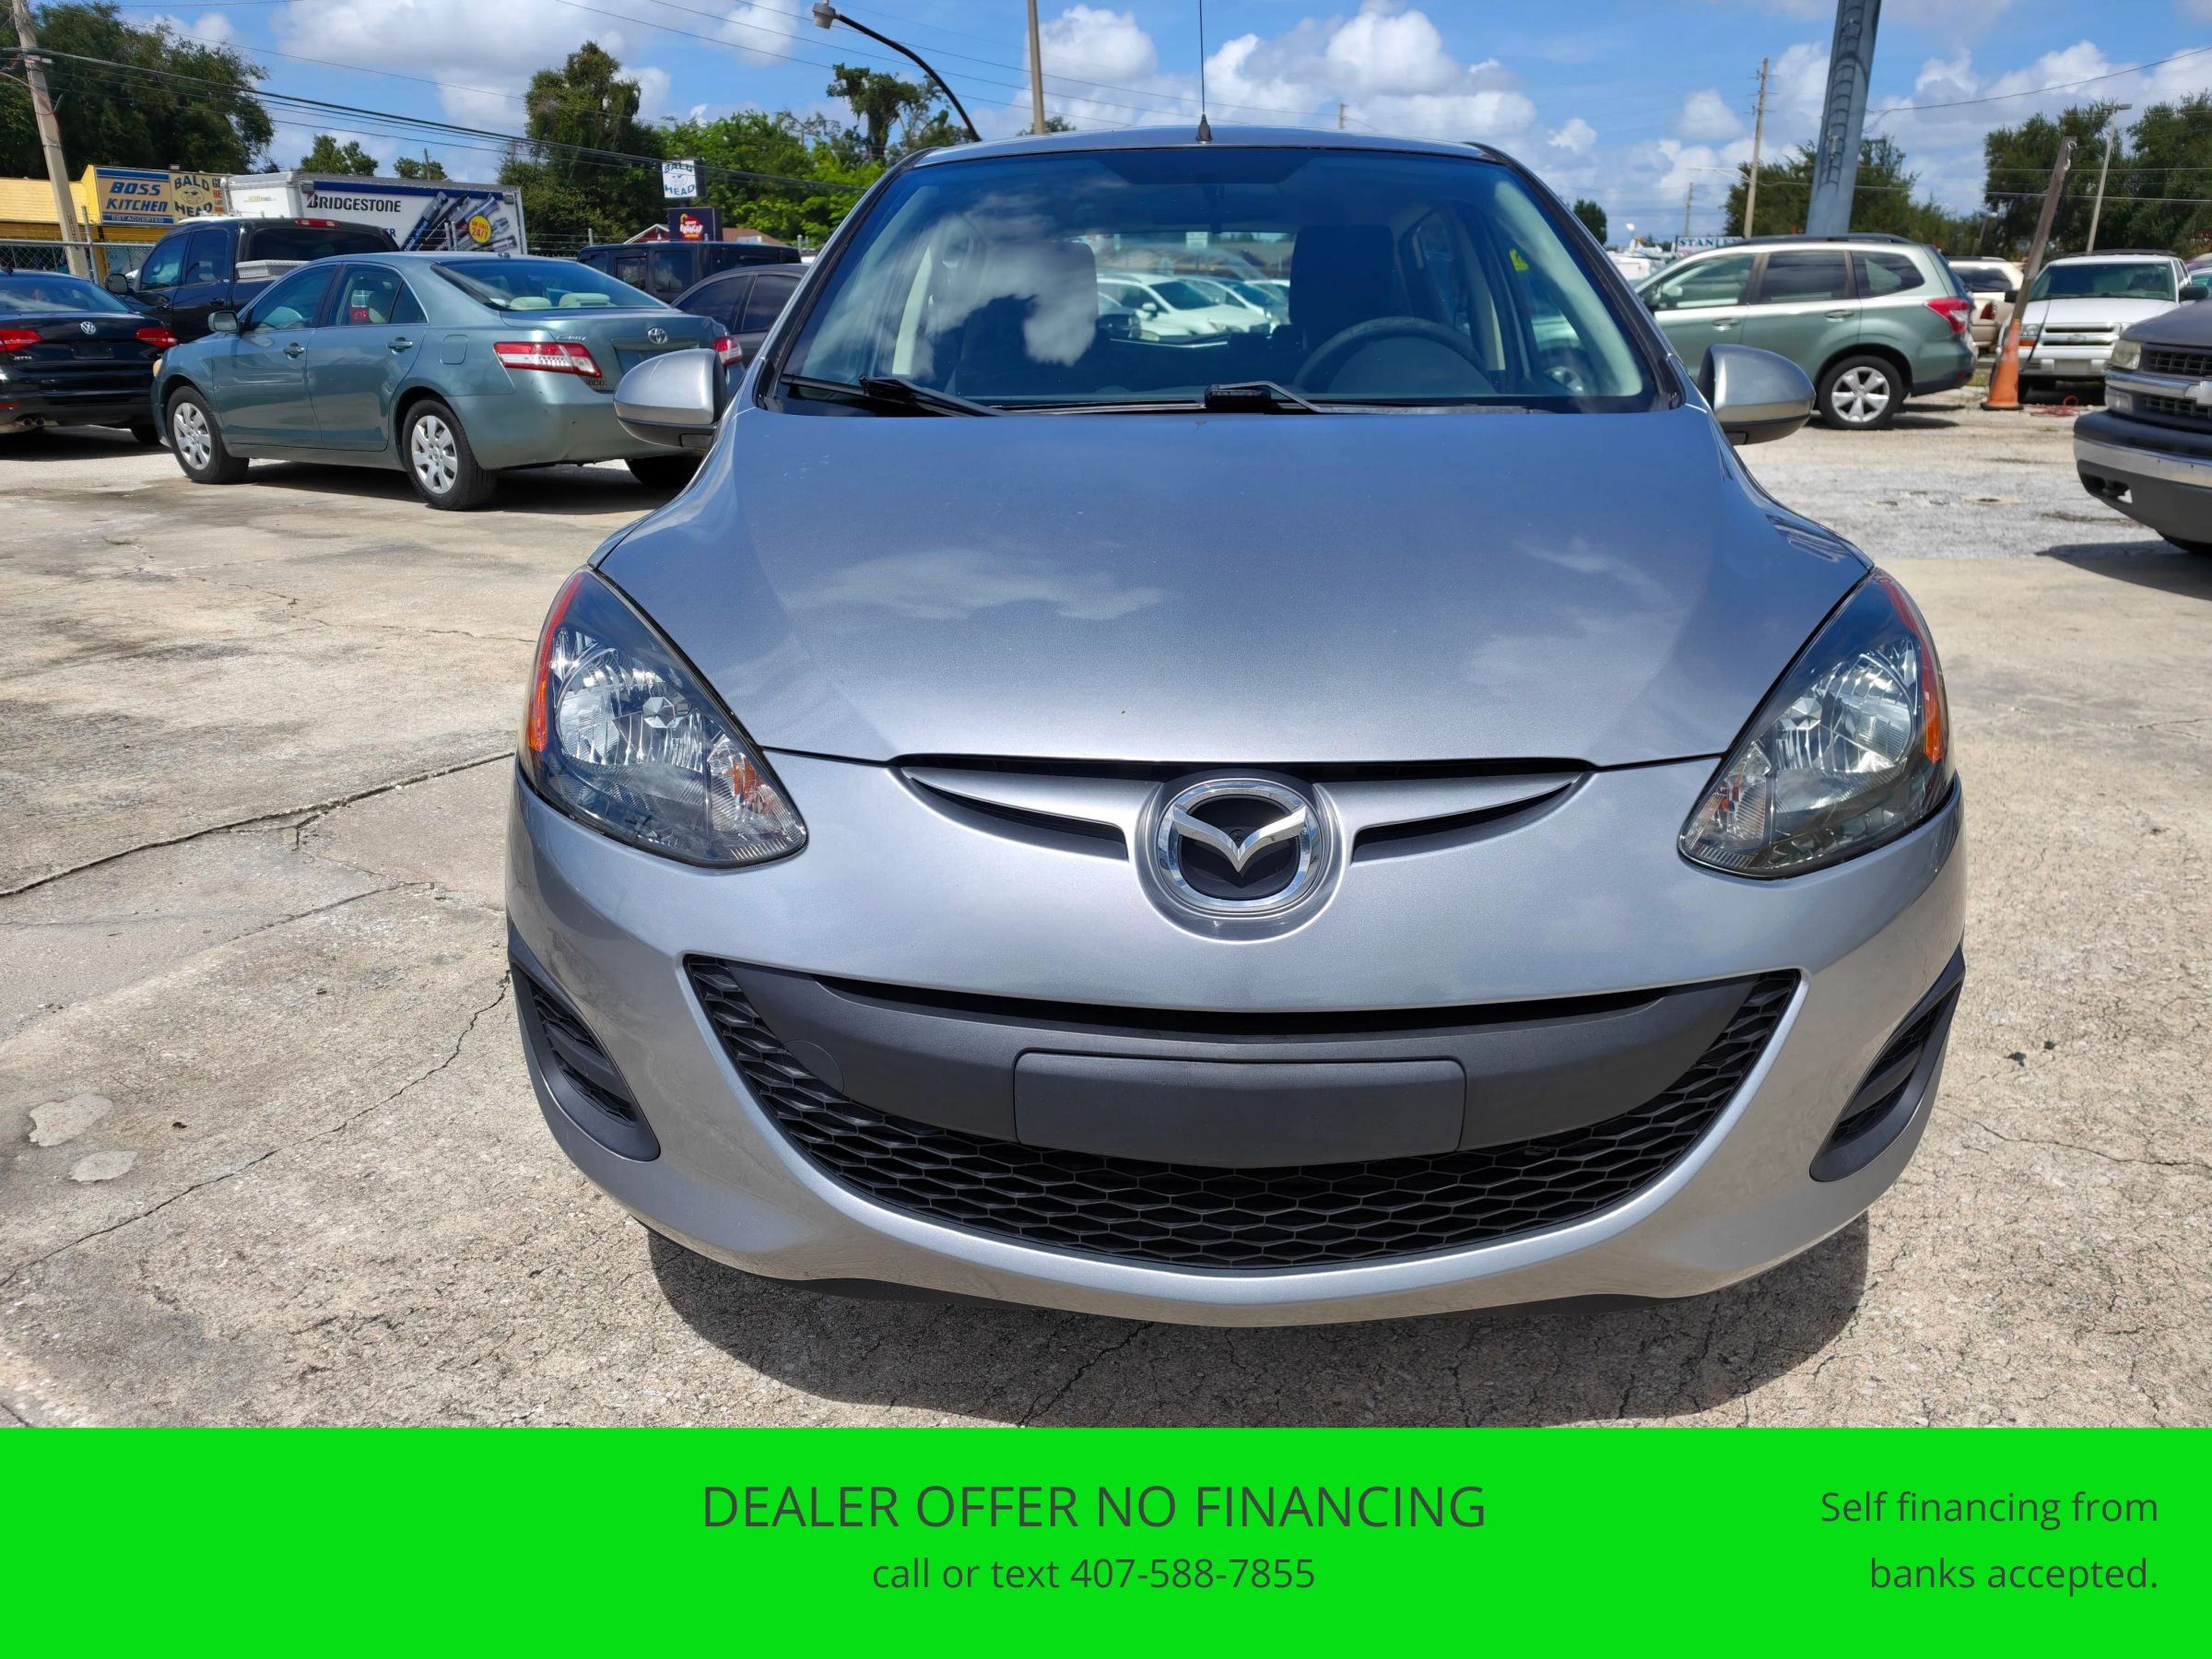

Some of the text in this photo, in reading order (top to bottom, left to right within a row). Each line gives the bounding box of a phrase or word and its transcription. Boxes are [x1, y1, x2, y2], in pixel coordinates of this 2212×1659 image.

[109, 182, 161, 196] BOSS
[173, 175, 210, 192] BALD
[665, 184, 696, 195] HEAD
[105, 198, 169, 212] KITCHEN
[173, 200, 213, 217] HEAD
[307, 192, 402, 213] BRIDGESTONE
[471, 228, 488, 240] 24/7
